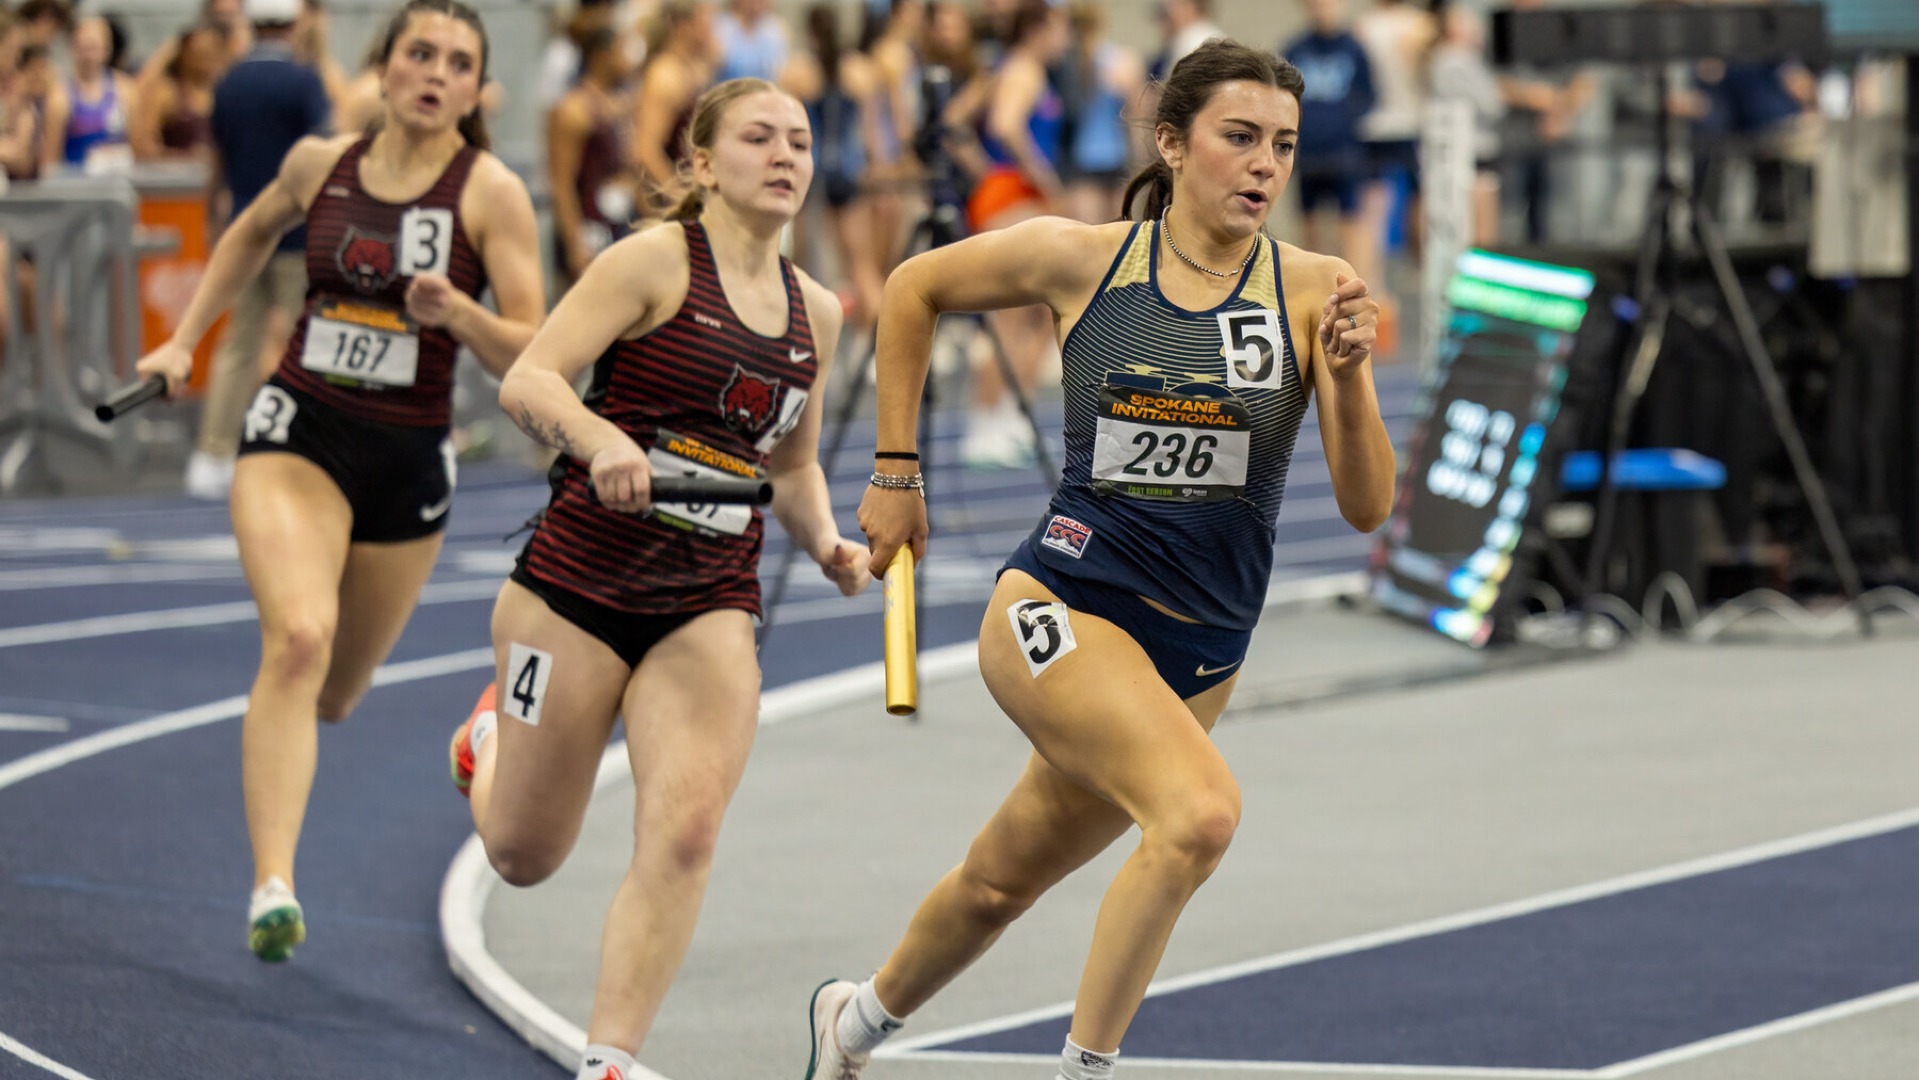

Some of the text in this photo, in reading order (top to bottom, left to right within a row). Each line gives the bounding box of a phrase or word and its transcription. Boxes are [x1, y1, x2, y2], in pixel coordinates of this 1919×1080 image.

[413, 219, 439, 270] 3
[333, 331, 391, 373] 167
[1228, 315, 1274, 382] 5
[1111, 403, 1238, 426] INVITATIONAL
[1129, 394, 1221, 414] SPOKANE
[1122, 431, 1218, 478] 236
[1016, 601, 1061, 664] 5
[513, 654, 540, 718] 4
